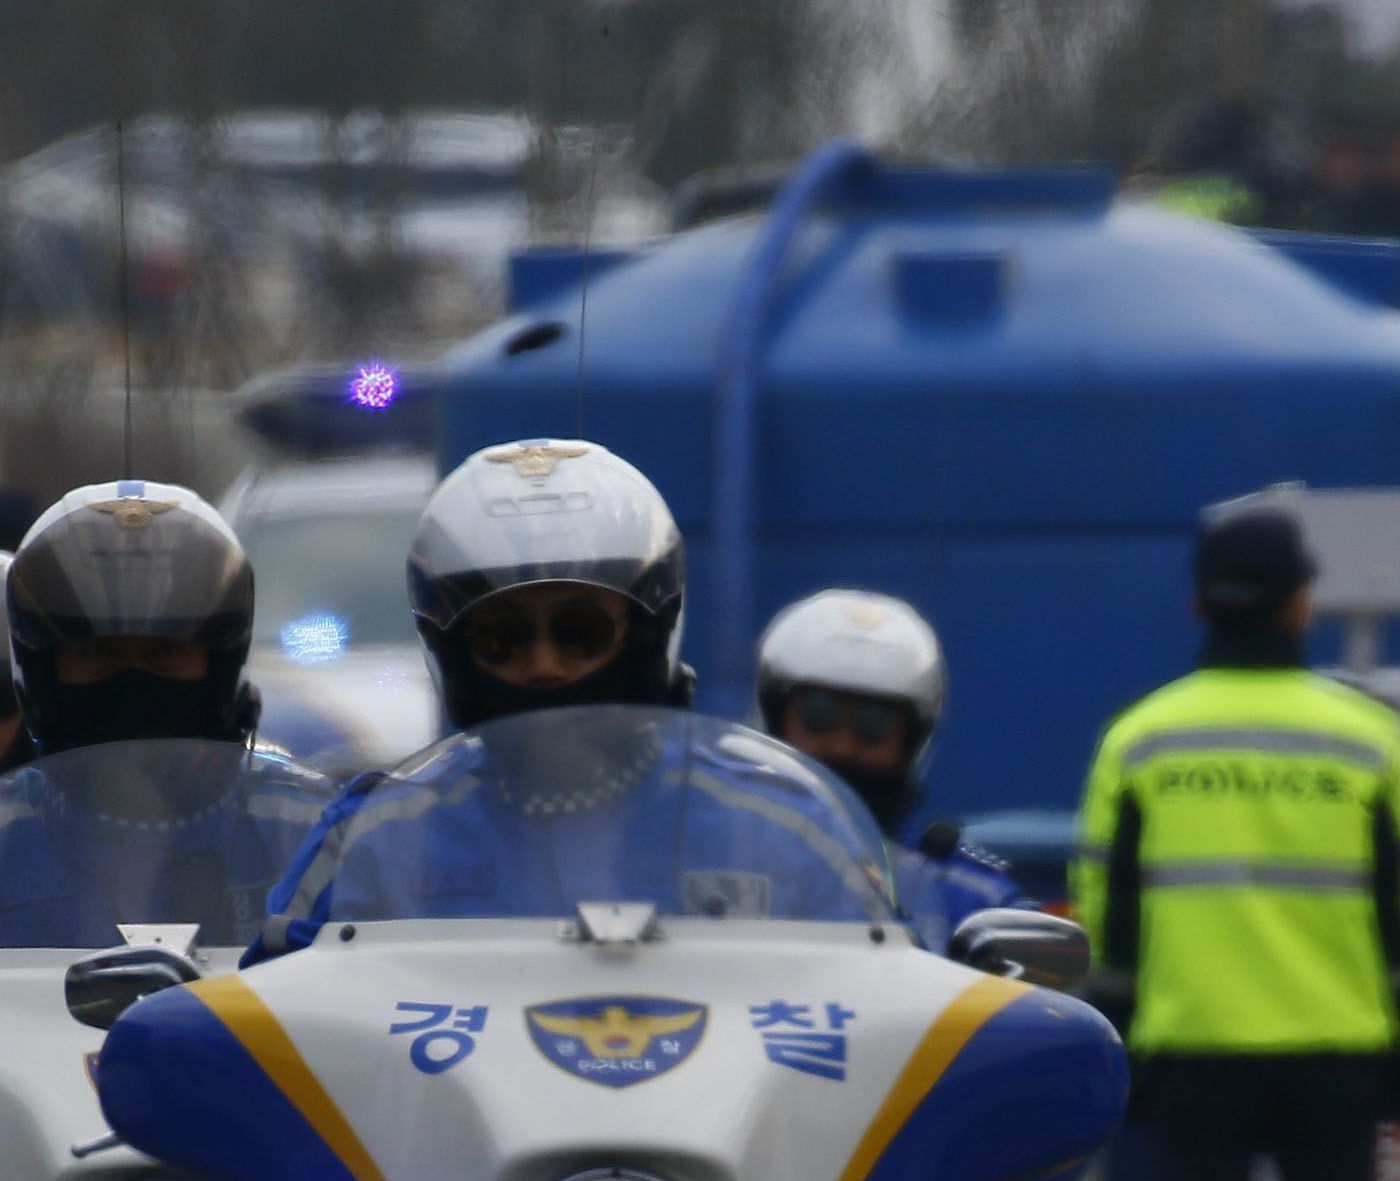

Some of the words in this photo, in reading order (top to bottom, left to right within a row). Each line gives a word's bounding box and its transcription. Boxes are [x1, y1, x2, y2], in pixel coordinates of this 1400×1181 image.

[389, 1001, 489, 1075] 경
[749, 1000, 856, 1082] 찰
[576, 1059, 657, 1074] POLICE
